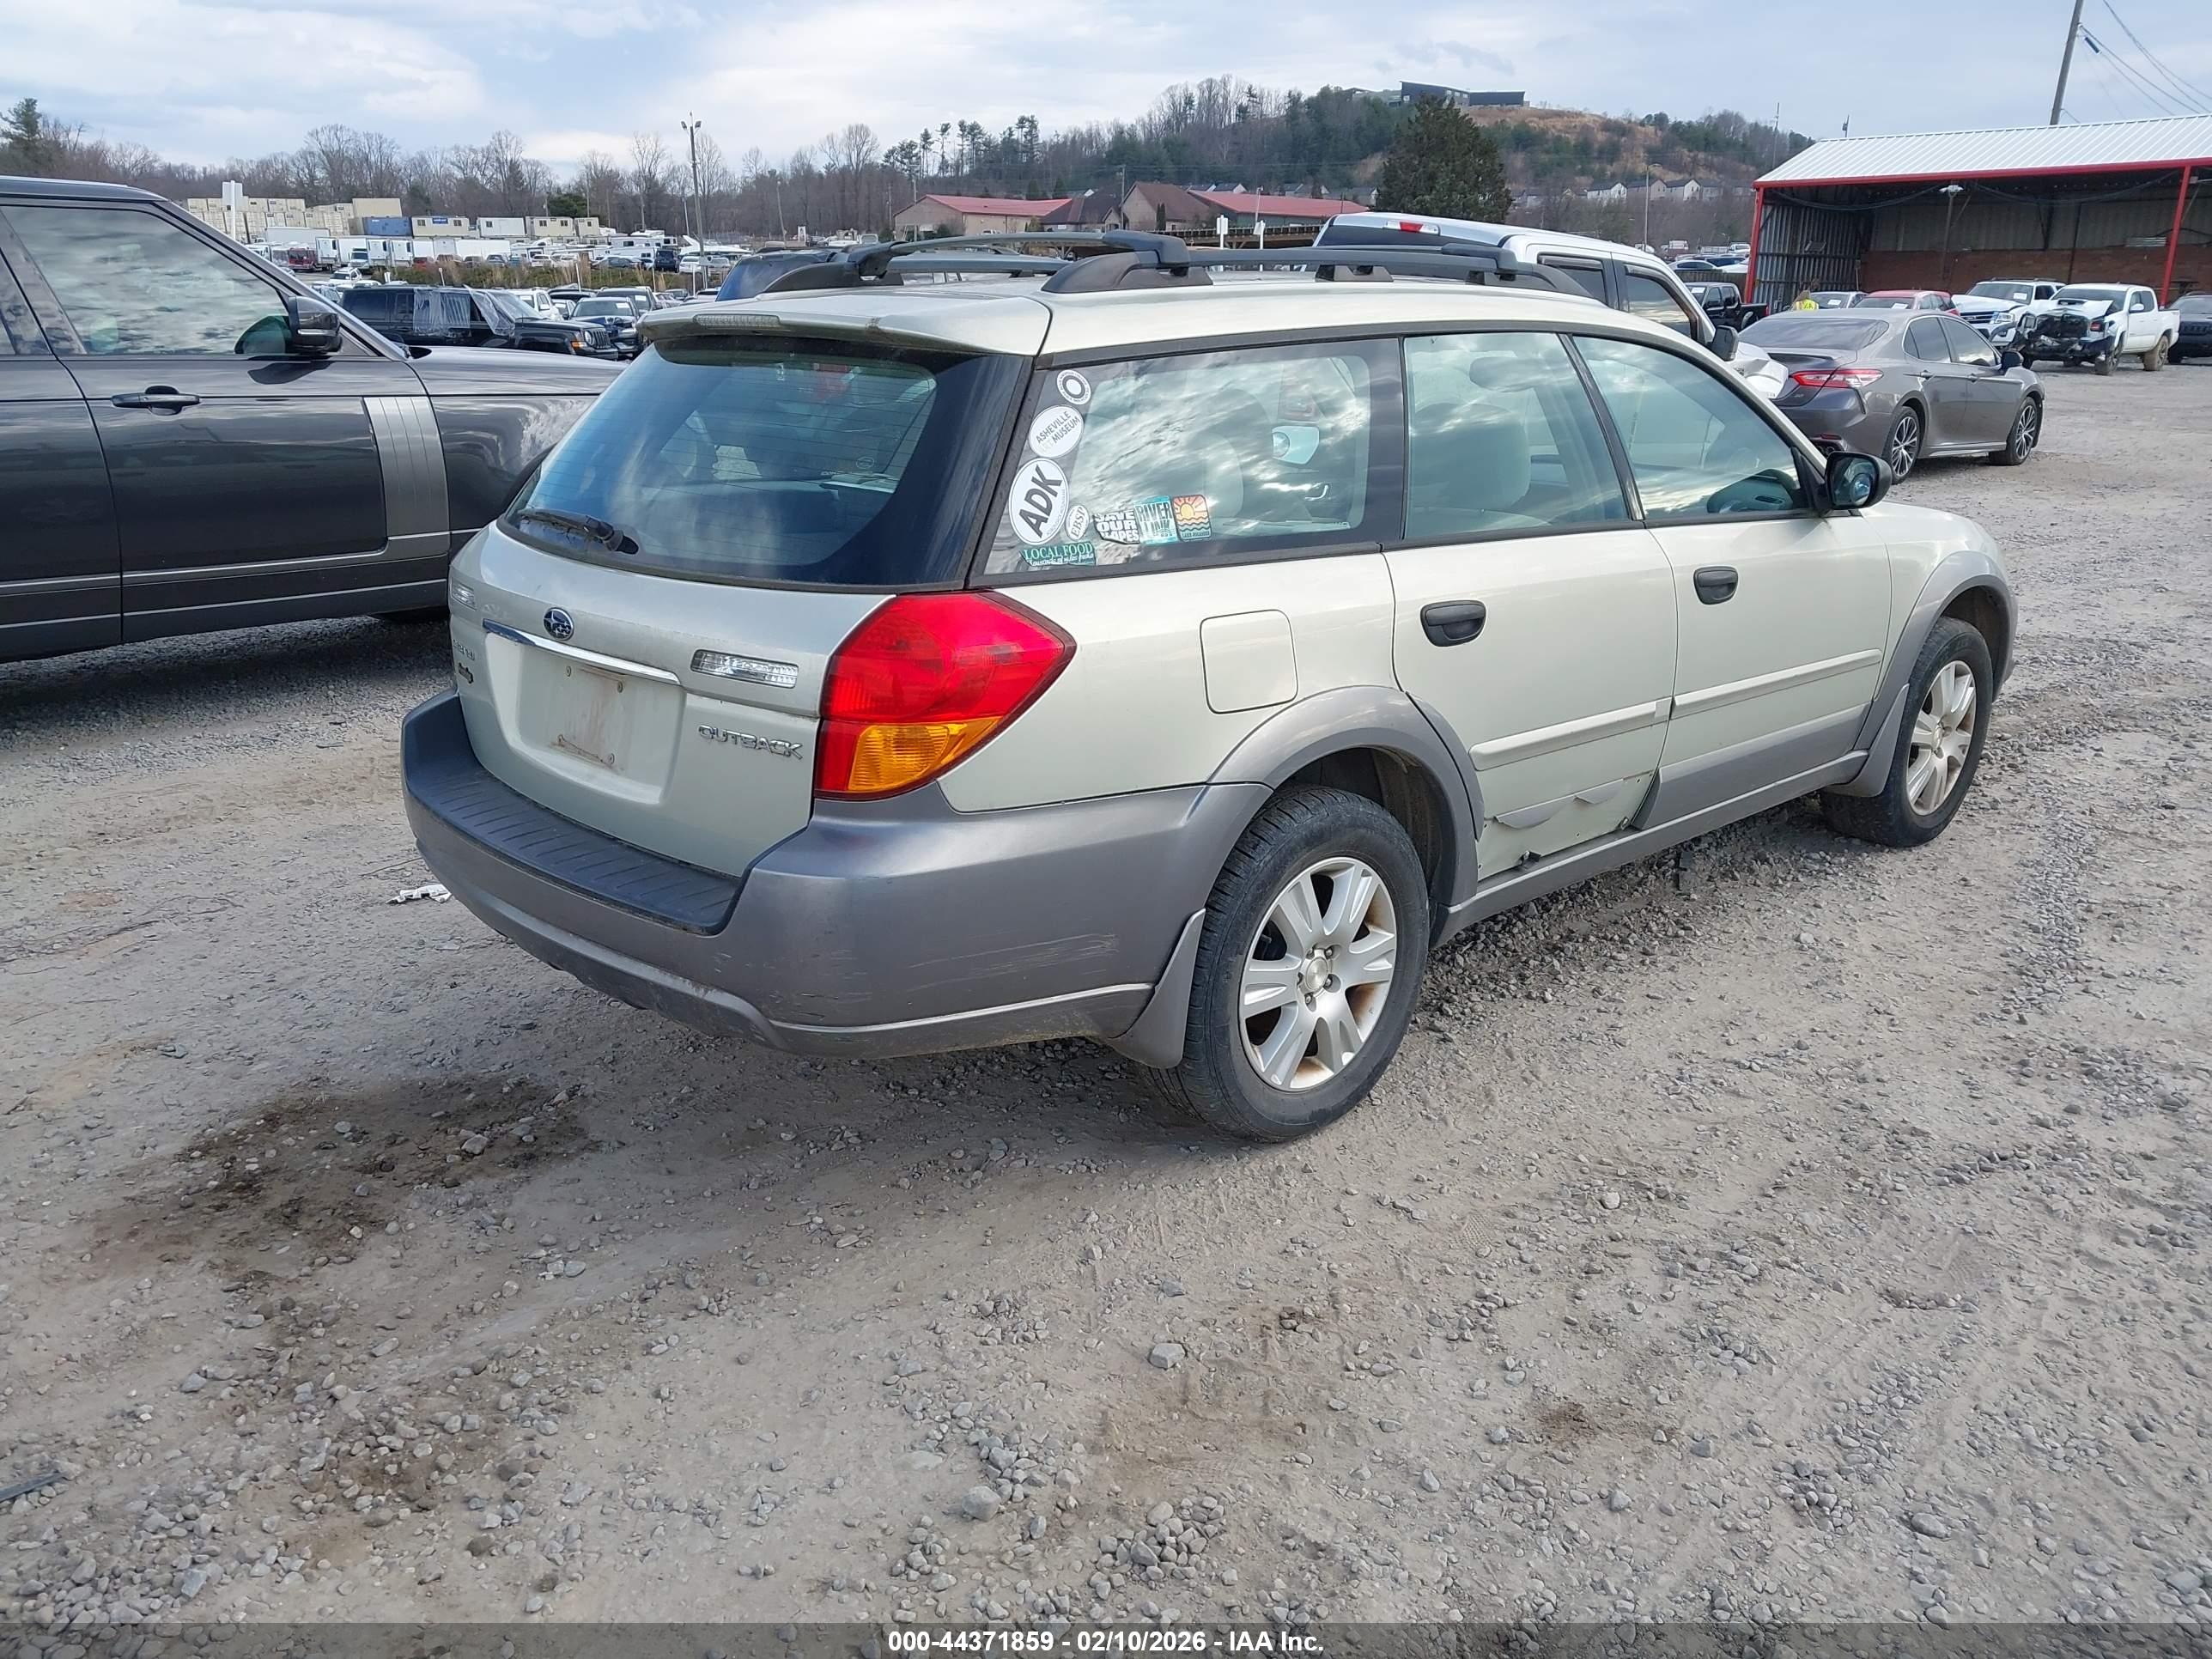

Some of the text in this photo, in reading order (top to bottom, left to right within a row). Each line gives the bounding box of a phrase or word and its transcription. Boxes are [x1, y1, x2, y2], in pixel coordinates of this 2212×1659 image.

[1036, 410, 1072, 444] ASHEVILLE
[1051, 416, 1081, 444] MUSEUM
[1018, 464, 1063, 539] ADK
[1134, 501, 1173, 522] RIVER
[1094, 509, 1135, 522] SAVE
[1096, 520, 1138, 532] OUR
[1024, 546, 1062, 560] LOCAL
[1062, 542, 1093, 556] FOOD
[698, 724, 804, 760] OUTBACK
